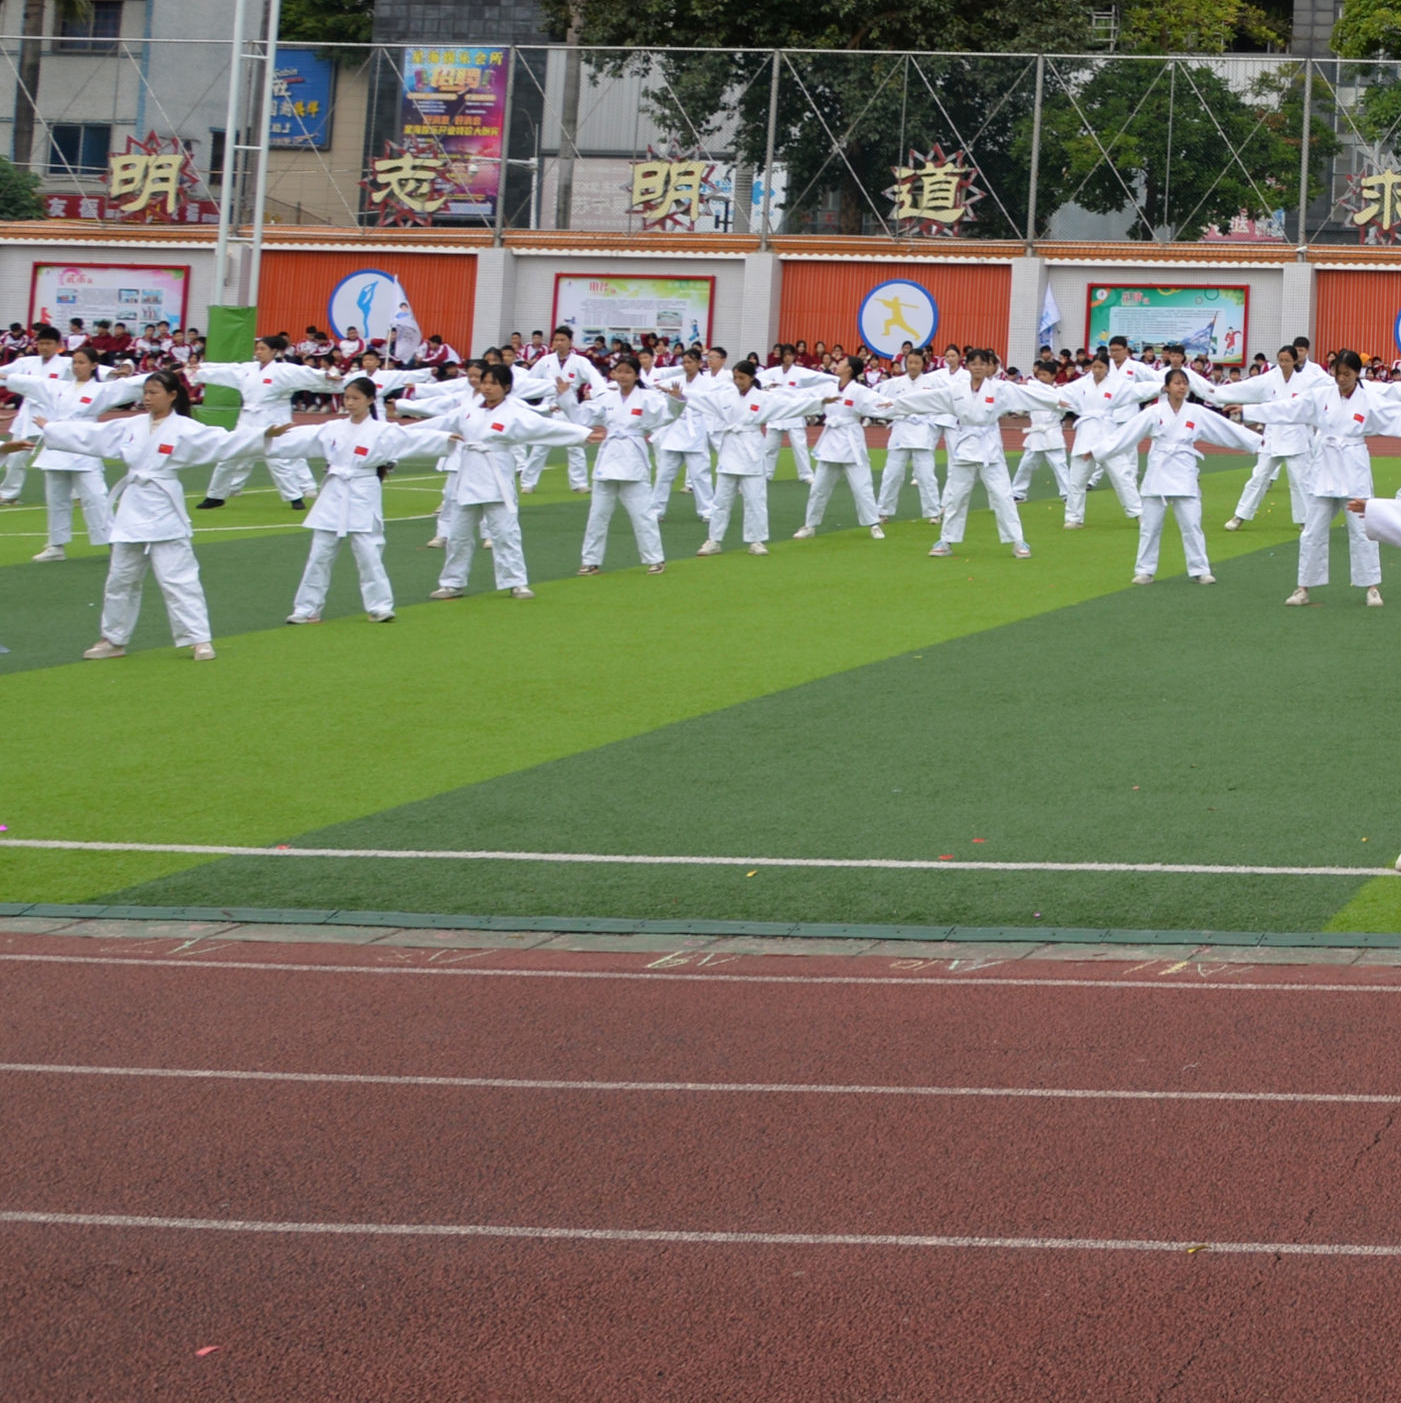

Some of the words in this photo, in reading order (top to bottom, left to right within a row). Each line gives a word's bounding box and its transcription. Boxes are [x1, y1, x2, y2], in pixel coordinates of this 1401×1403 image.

[109, 154, 184, 213] 明
[372, 154, 447, 211] 志
[632, 161, 706, 221] 明
[892, 163, 967, 222] 道
